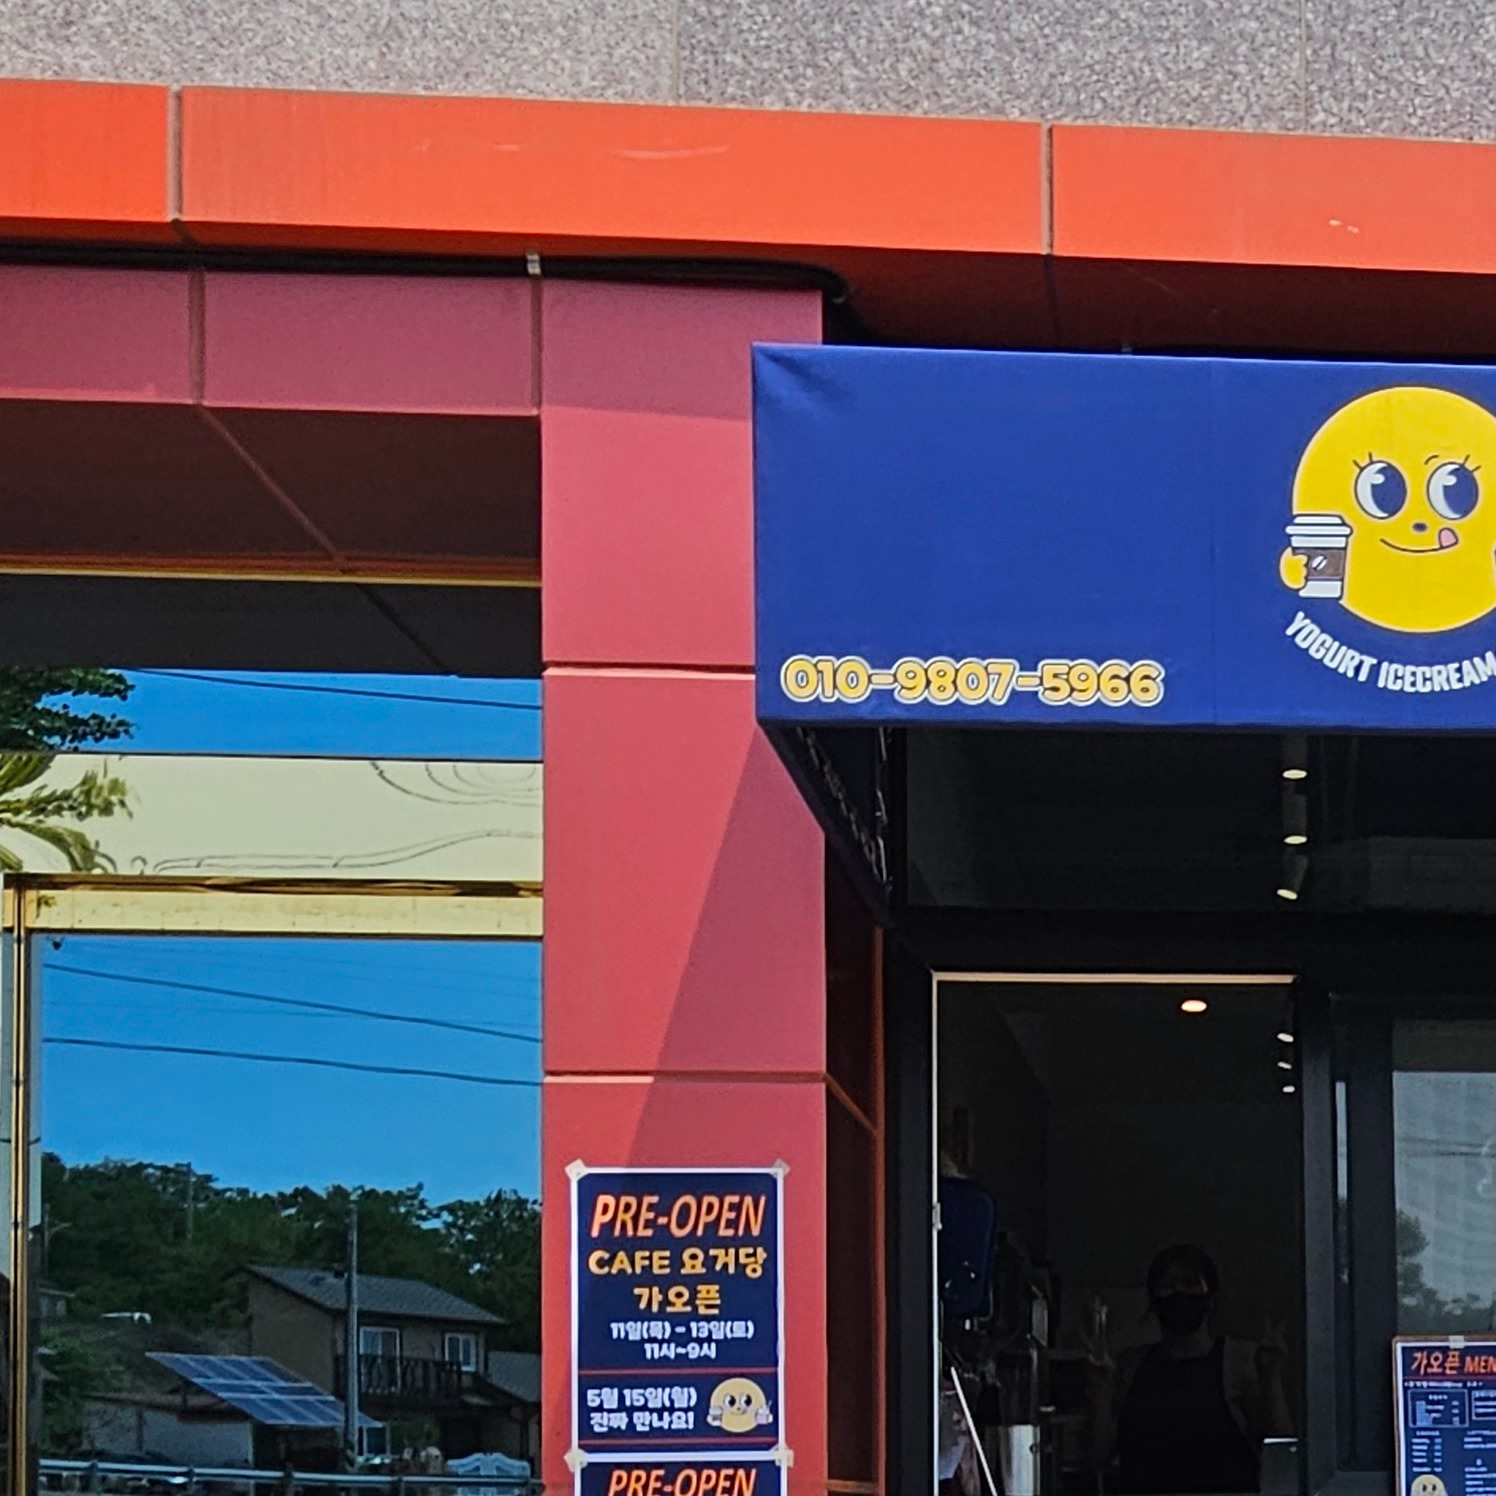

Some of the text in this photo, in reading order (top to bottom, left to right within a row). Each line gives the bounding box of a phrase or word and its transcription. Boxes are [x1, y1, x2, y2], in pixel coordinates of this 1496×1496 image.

[1285, 611, 1377, 682] YOGURT
[781, 655, 1165, 706] 010-9807-5966
[590, 1194, 766, 1238] PRE-OPEN
[588, 1247, 767, 1278] CAFE 요거당
[633, 1284, 721, 1315] 가오픈
[1411, 1351, 1460, 1376] 가오픈
[586, 1387, 619, 1409] 5월
[633, 1412, 694, 1431] 만나요!
